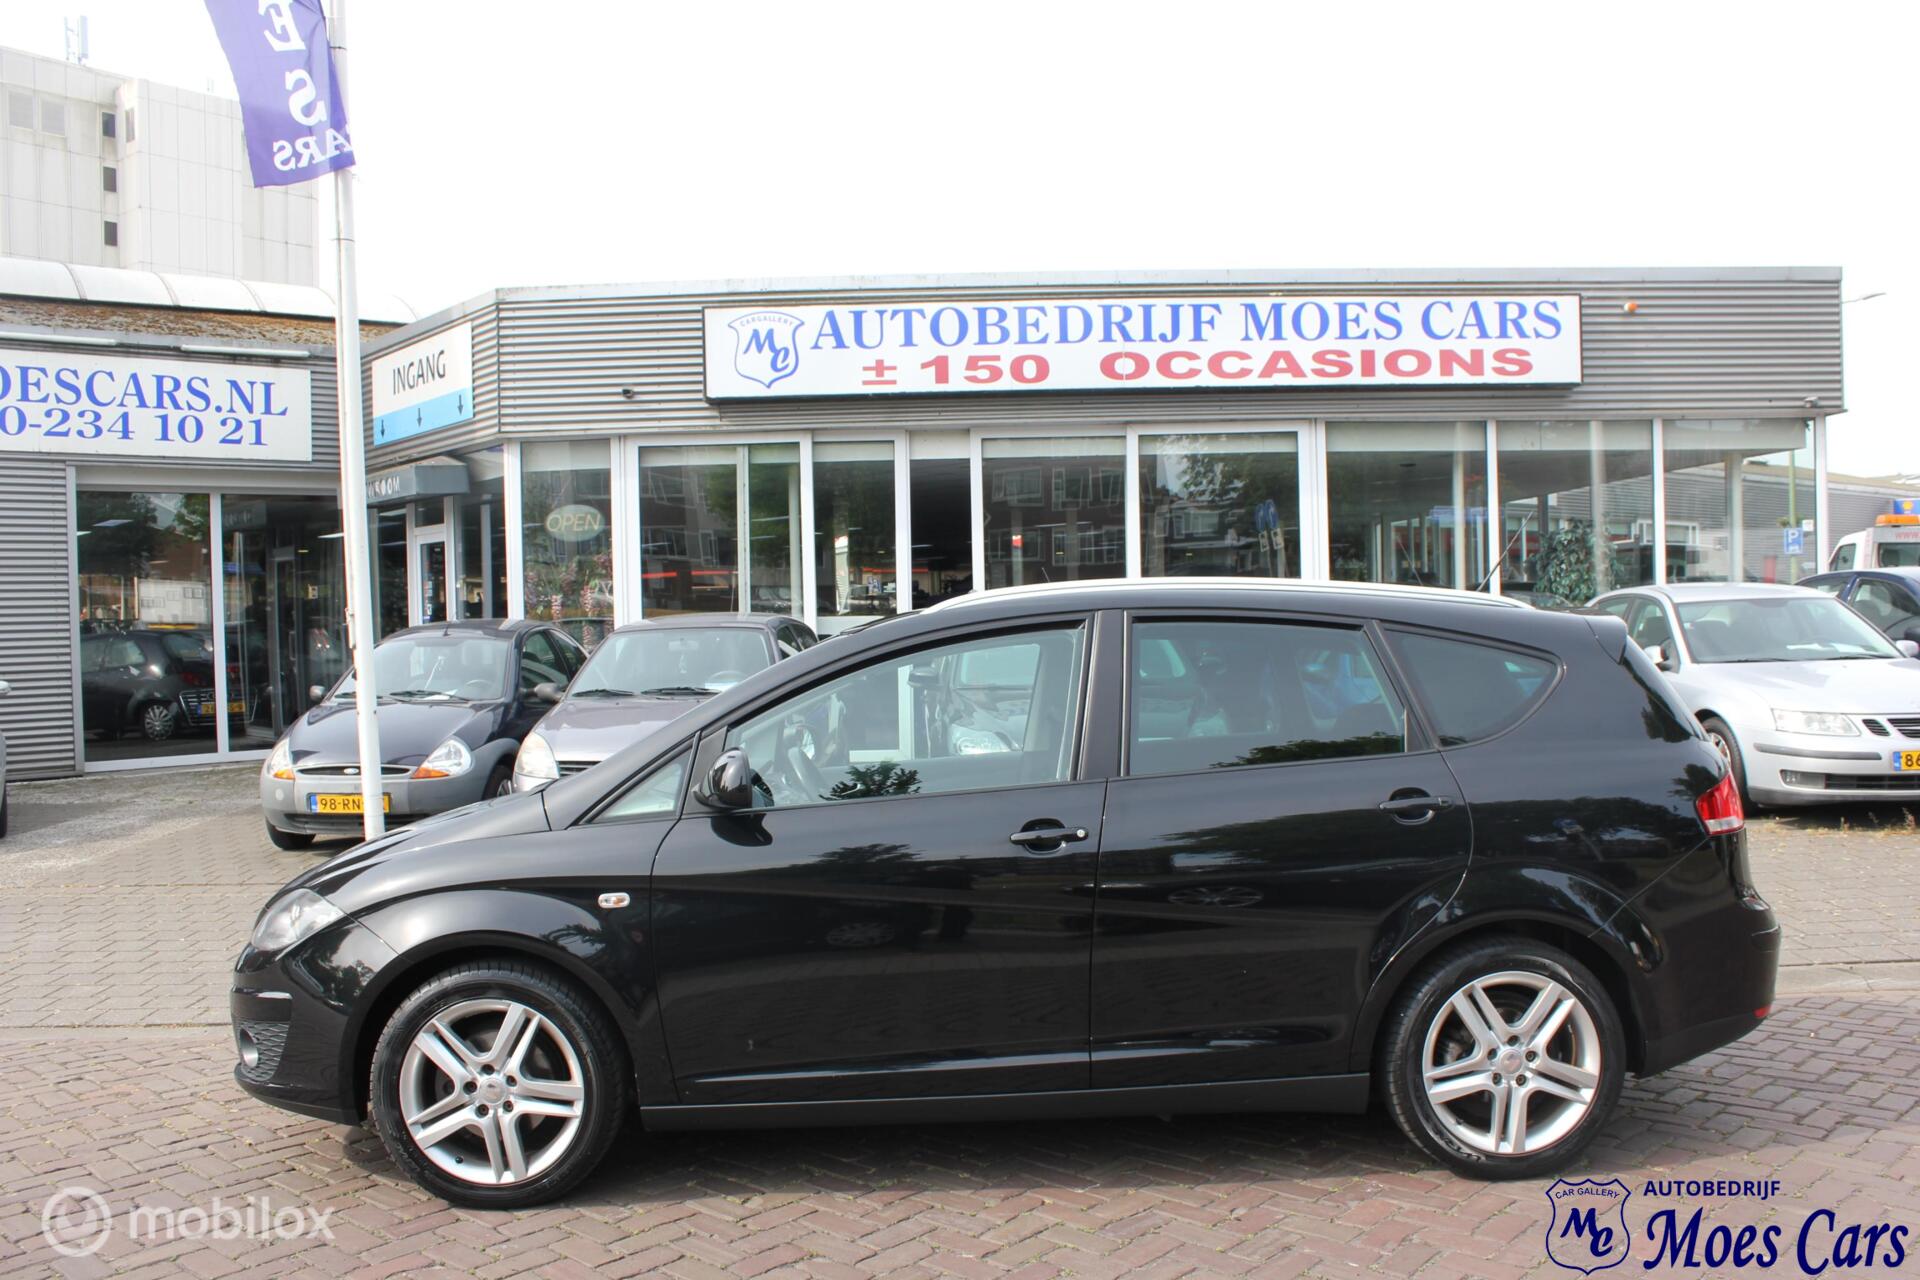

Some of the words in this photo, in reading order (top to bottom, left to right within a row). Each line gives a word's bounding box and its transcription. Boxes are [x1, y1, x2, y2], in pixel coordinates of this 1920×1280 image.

[810, 304, 1222, 350] AUTOBEDRIJF
[1240, 301, 1402, 342] MOES
[1421, 299, 1562, 340] CARS
[392, 349, 446, 396] INGANG
[919, 354, 1050, 385] 150
[1099, 347, 1534, 381] OCCASIONS
[0, 405, 135, 440] 0-234
[153, 413, 204, 443] 10
[218, 417, 268, 446] 21
[546, 513, 600, 533] OPEN
[1788, 529, 1799, 543] P
